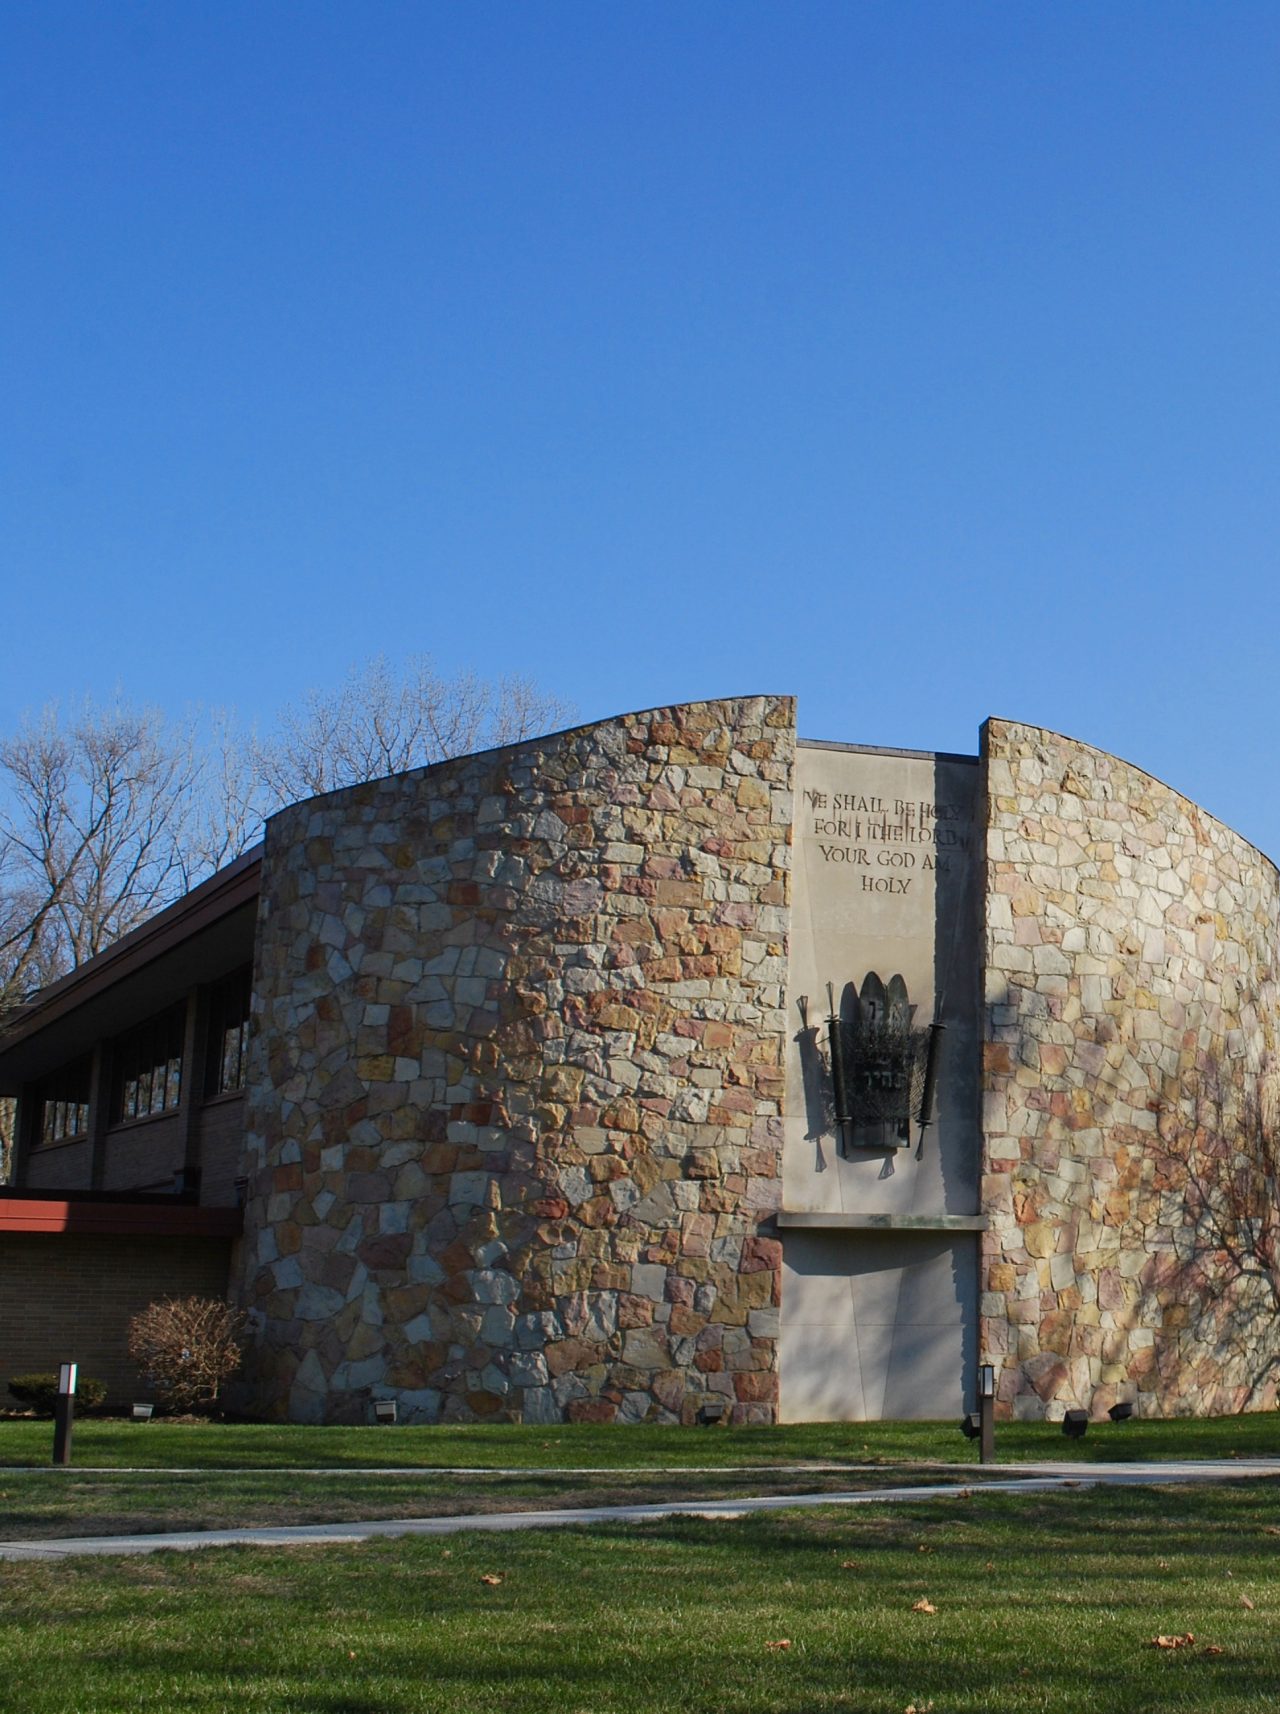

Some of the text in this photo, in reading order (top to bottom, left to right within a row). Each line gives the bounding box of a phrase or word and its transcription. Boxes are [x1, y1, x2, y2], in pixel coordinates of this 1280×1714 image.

[833, 793, 888, 813] SHALL
[894, 799, 915, 817] BE
[814, 818, 851, 837] FOR
[869, 823, 903, 842] THE
[819, 845, 951, 872] YOUR GOD AM
[862, 875, 912, 894] HOLY
